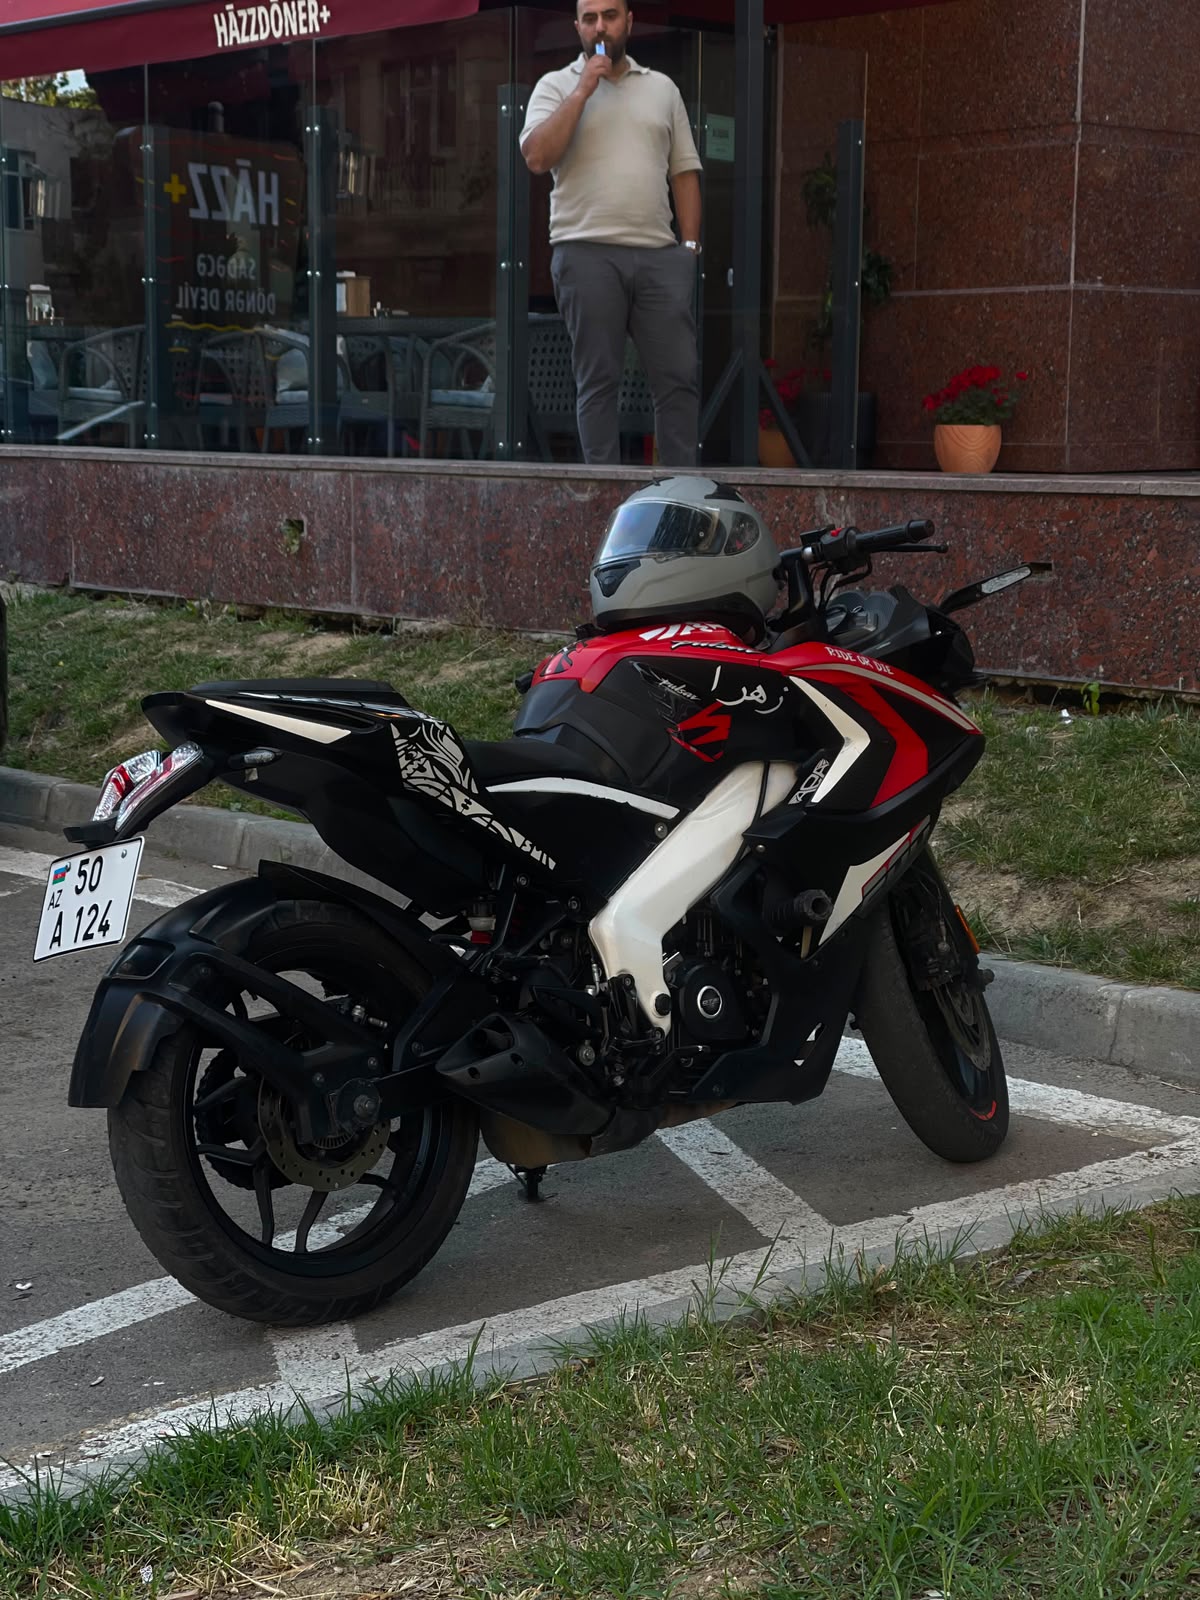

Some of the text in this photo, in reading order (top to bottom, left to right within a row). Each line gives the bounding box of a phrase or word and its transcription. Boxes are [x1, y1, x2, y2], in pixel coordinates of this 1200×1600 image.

[824, 646, 894, 675] RIDE OR DIE
[74, 855, 103, 895] 50
[47, 889, 63, 911] AZ
[49, 899, 112, 949] A 124
